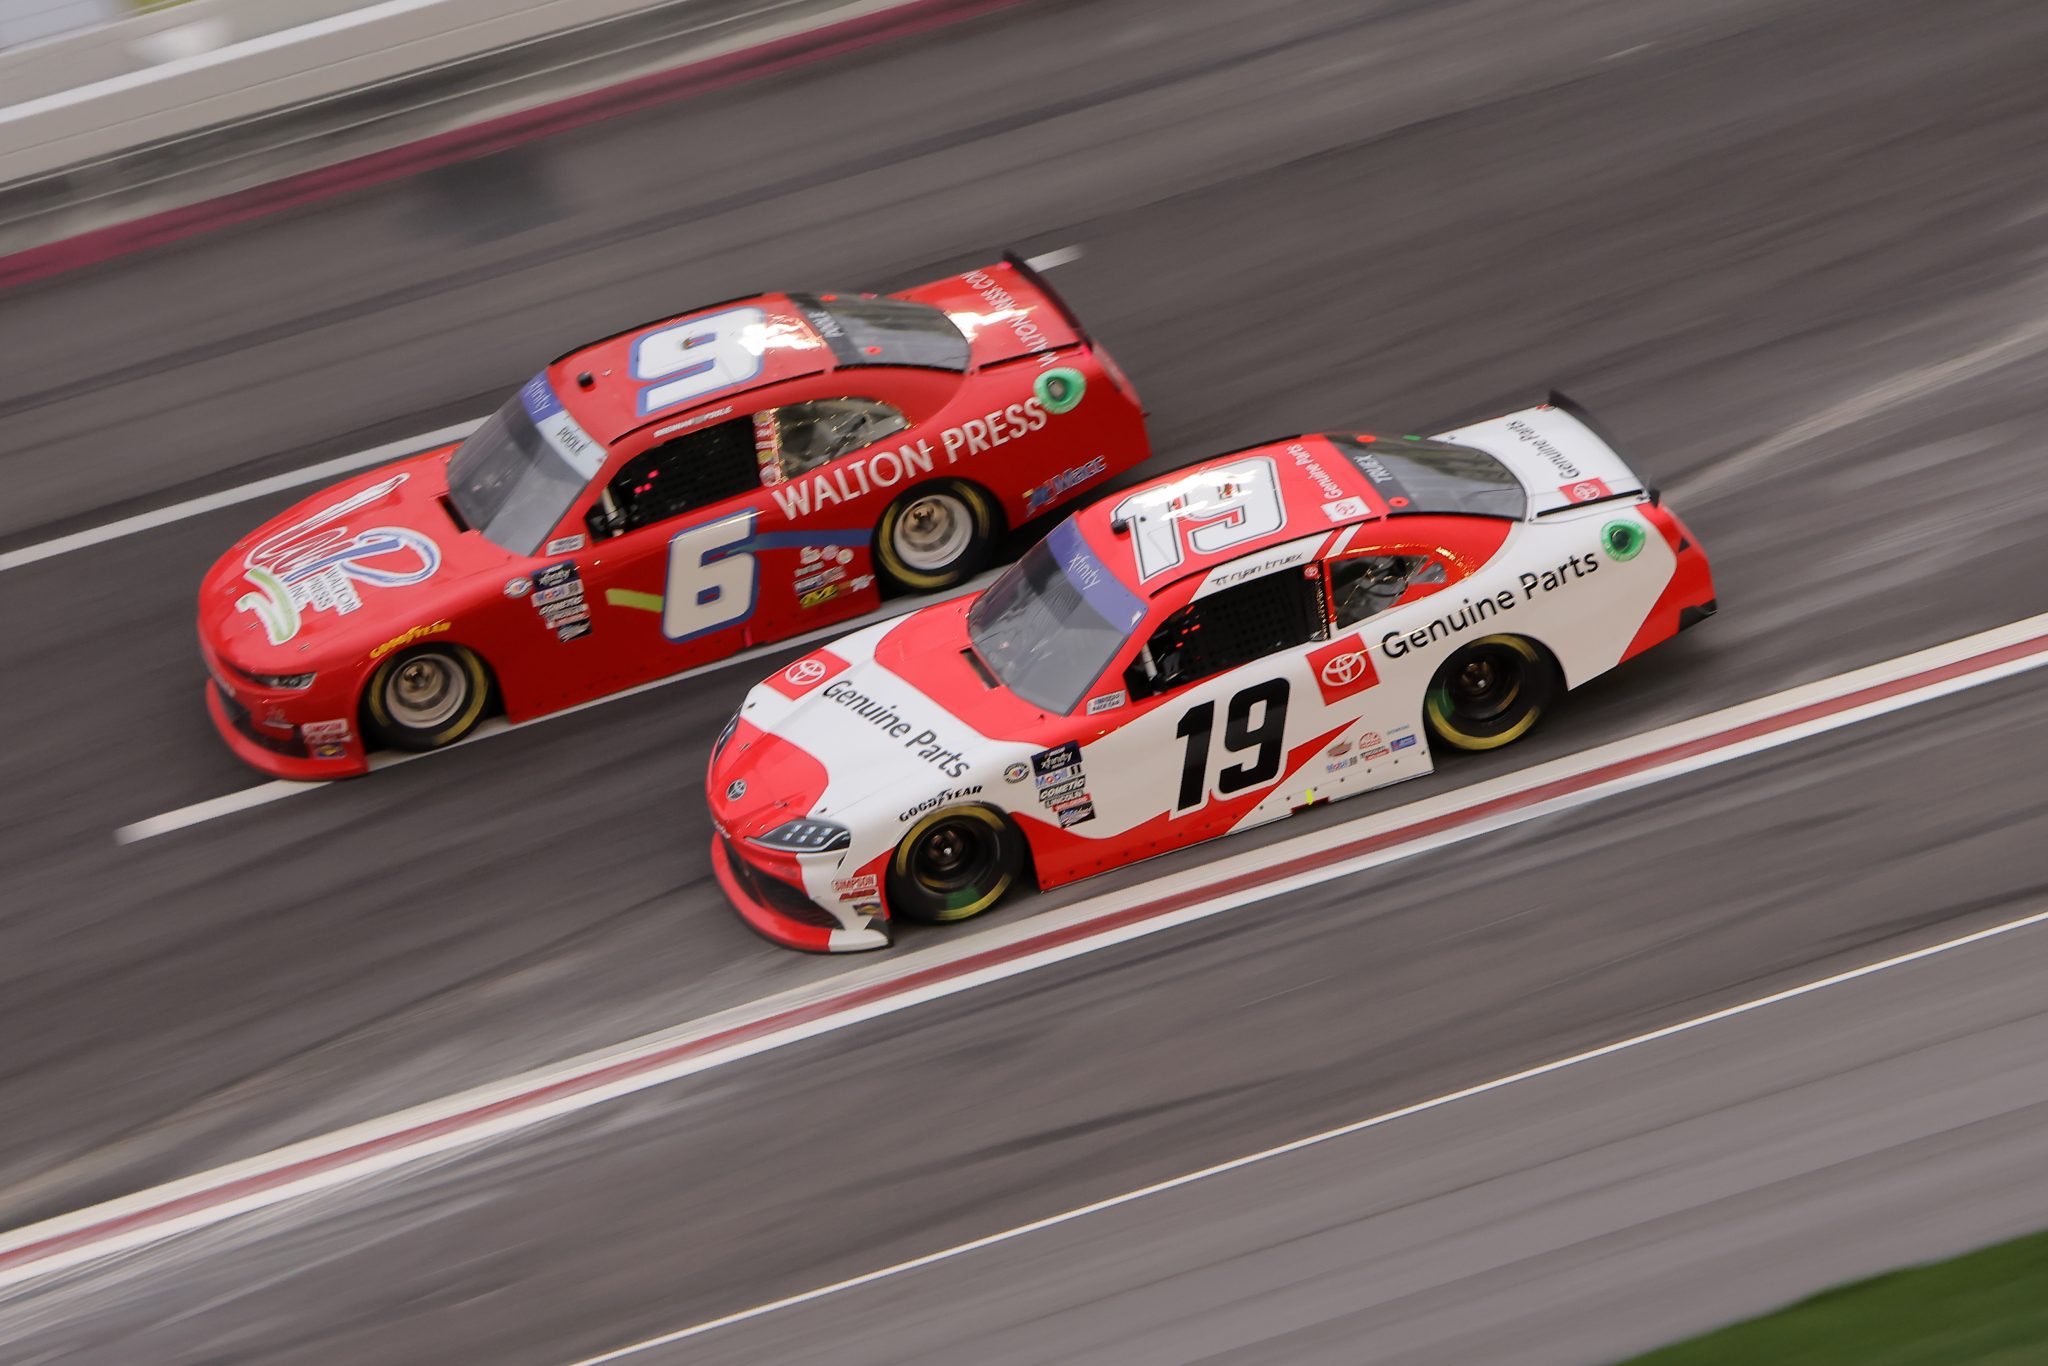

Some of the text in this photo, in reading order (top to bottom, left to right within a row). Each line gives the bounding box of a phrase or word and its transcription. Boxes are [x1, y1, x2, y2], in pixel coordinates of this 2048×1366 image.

[771, 438, 935, 521] WALTON
[939, 396, 1048, 464] PRESS
[1506, 419, 1581, 480] Genuine Parts
[1110, 455, 1287, 585] 19
[662, 506, 760, 643] 6
[1381, 552, 1599, 660] Genuine Parts
[822, 680, 912, 739] Genuine
[905, 729, 970, 779] Parts
[1176, 677, 1290, 812] 19
[898, 784, 983, 822] GOODYEAR
[1040, 777, 1084, 800] COMETIC
